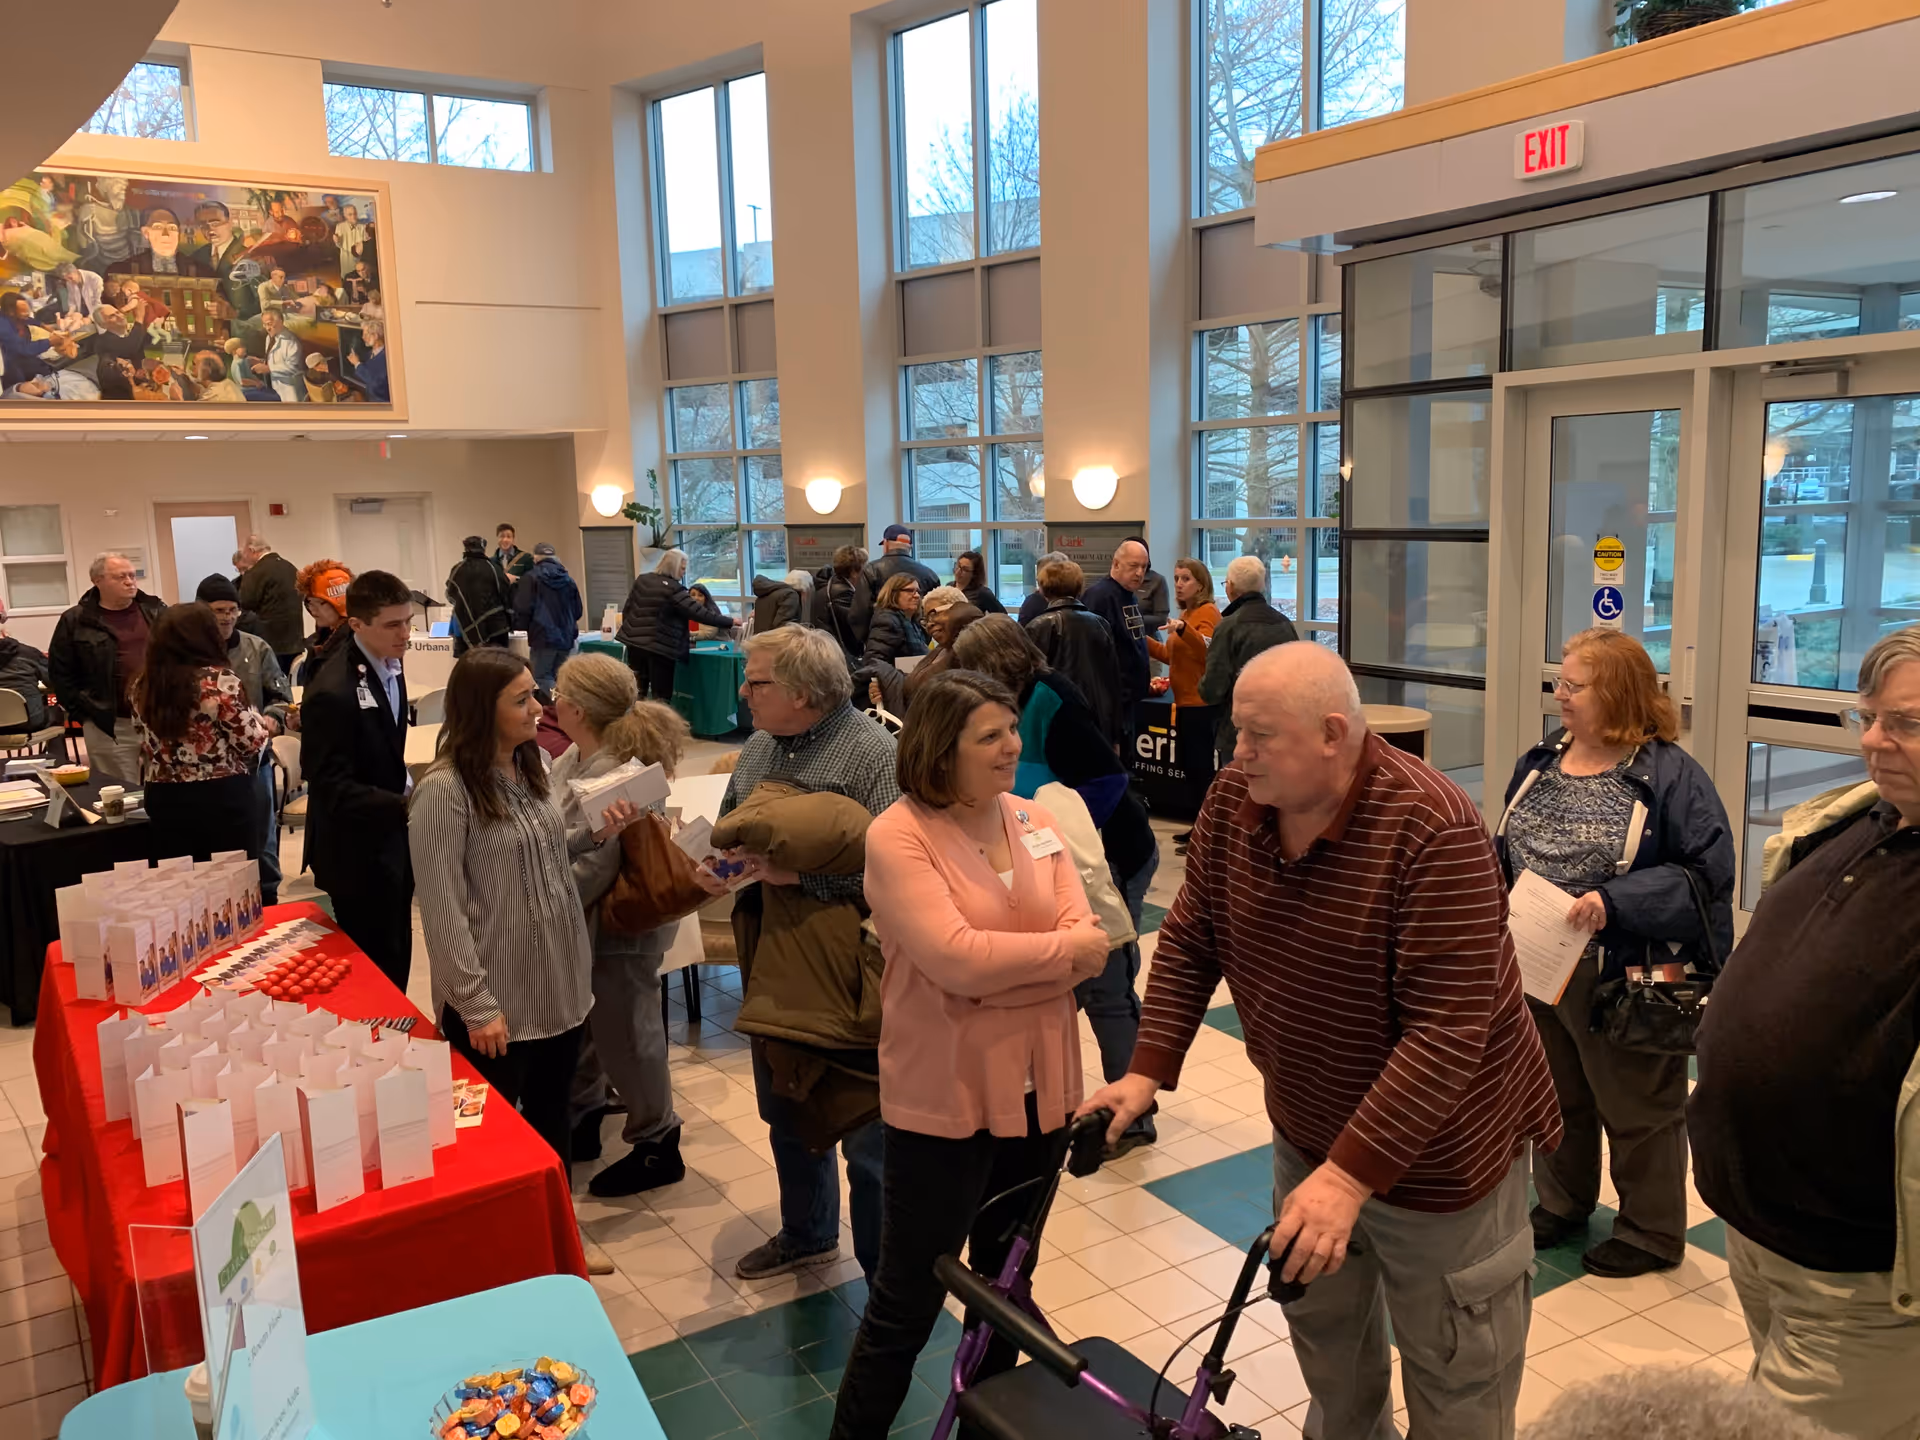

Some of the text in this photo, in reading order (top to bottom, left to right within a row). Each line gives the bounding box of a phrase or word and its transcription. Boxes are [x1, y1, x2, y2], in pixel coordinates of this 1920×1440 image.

[1524, 124, 1570, 174] EXIT
[414, 642, 450, 652] Urbana
[1132, 761, 1164, 775] FFING
